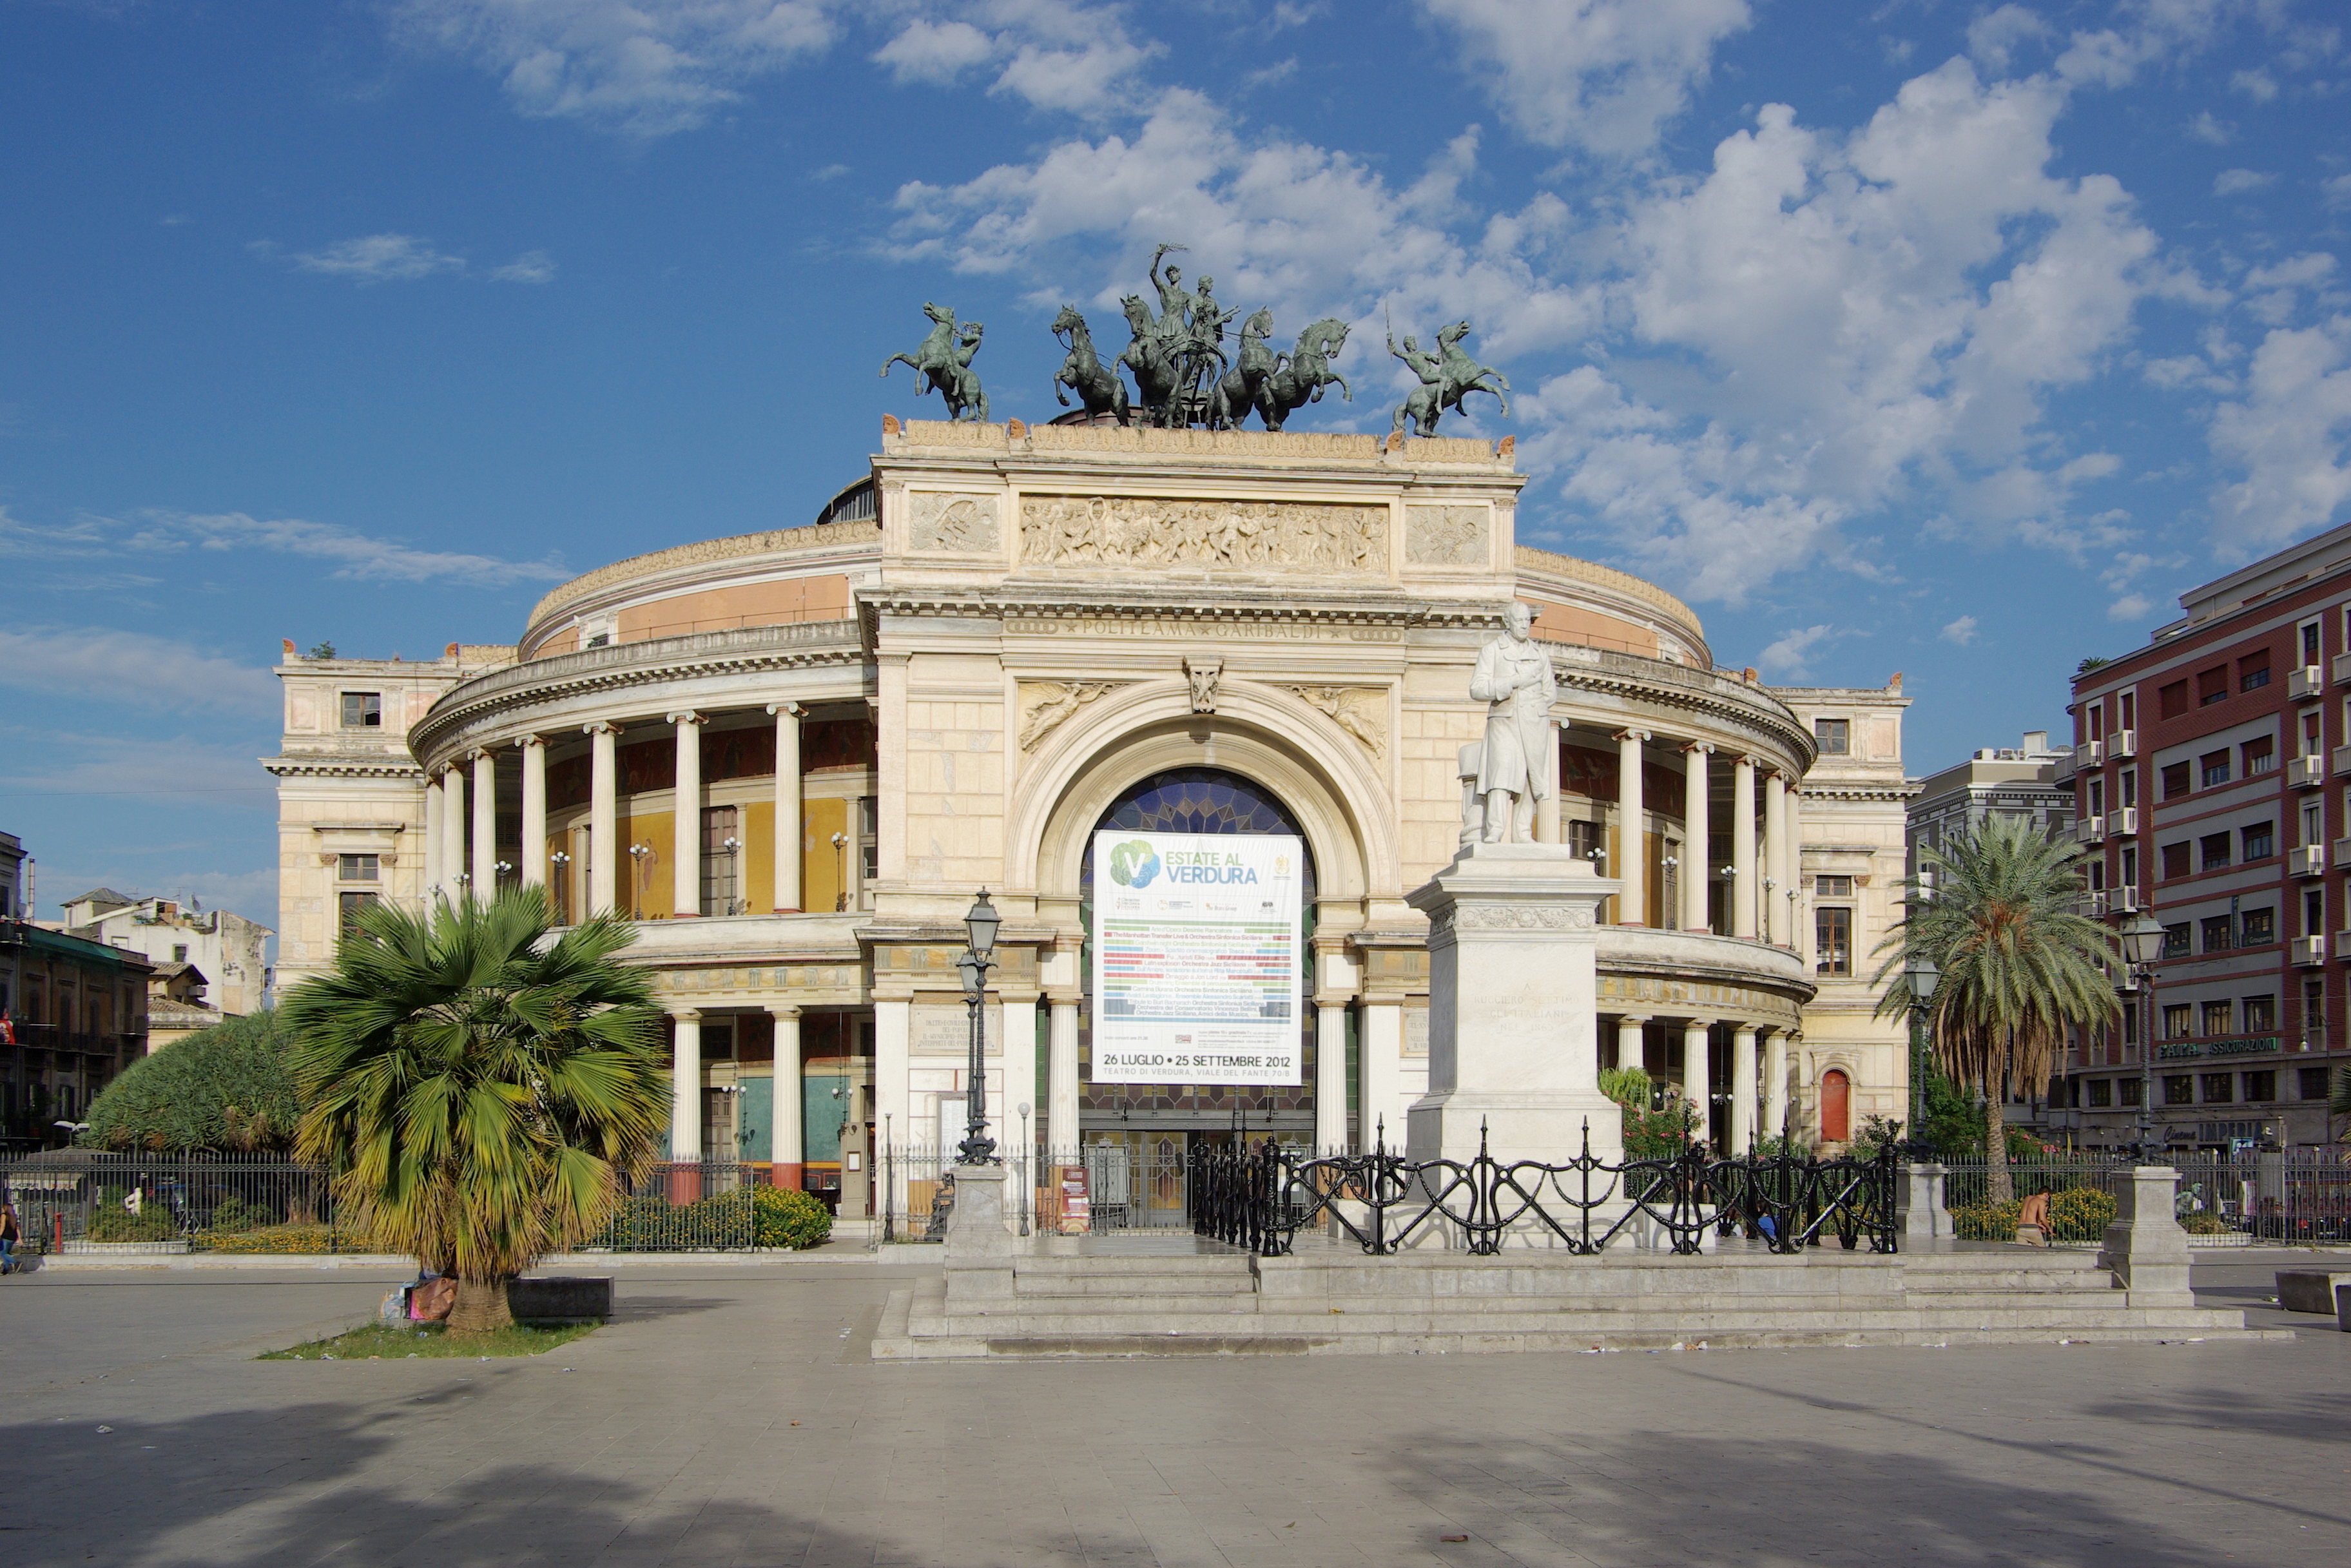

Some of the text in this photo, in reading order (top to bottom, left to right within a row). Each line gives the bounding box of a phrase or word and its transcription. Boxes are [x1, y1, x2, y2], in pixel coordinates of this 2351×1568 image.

[1083, 620, 1321, 639] POLITEAMA GARIBALDI
[1166, 851, 1244, 866] ESTATE AL
[1166, 866, 1258, 884] VERDURA
[1474, 996, 1580, 1004] RUGGIERO SETTIMO
[1490, 1009, 1564, 1018] GLI ITALIANI
[1500, 1023, 1521, 1032] NEL
[2209, 1037, 2278, 1055] ASSICURAZIONI
[1104, 1054, 1290, 1068] 26 LUGLIO 25 SETTEMBRE 2012
[1152, 1069, 1193, 1078] VERDURA,
[2163, 1122, 2265, 1143] Cinema IMPERIA
